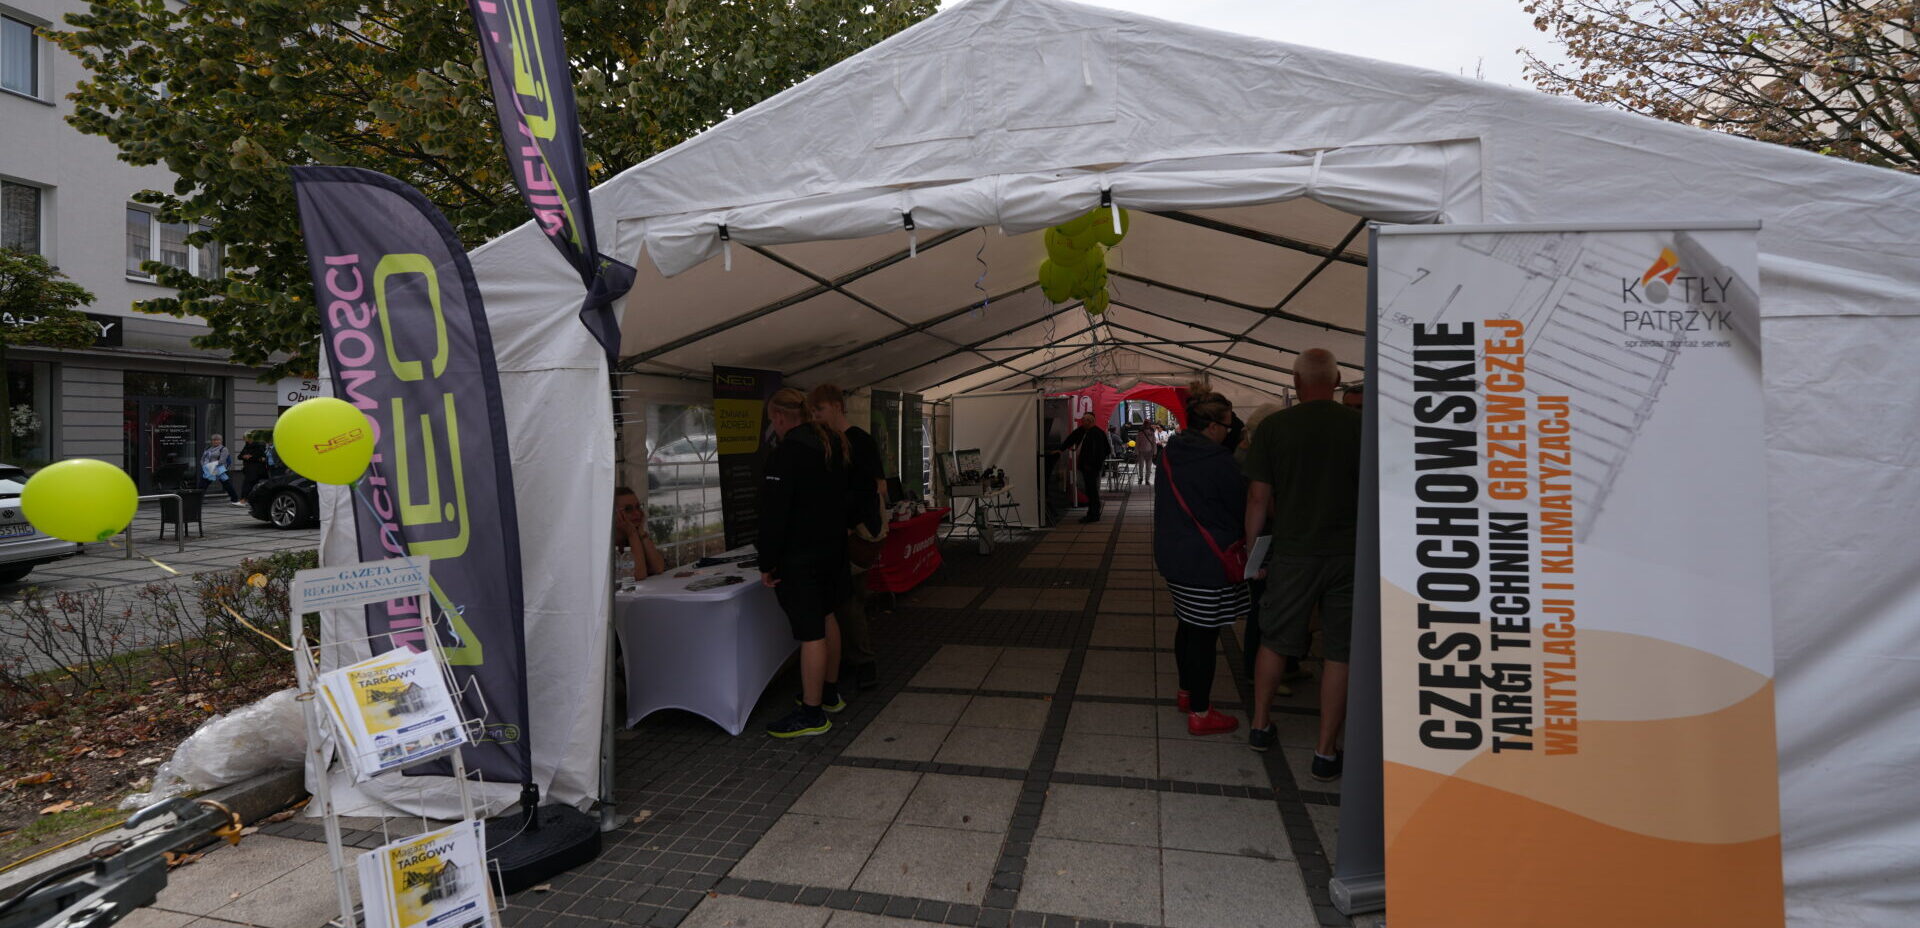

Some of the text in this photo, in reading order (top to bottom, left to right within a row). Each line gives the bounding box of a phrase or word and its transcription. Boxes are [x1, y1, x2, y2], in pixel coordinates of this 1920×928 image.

[1623, 310, 1733, 331] PATRZYK
[1701, 340, 1731, 348] serwis
[715, 374, 755, 387] NEO
[313, 428, 362, 451] NEO
[1484, 319, 1533, 754] TARGI TECHNIKI GRZEWCZEJ
[338, 565, 392, 580] GAZETA
[1537, 395, 1579, 756] WENTYLACJI I KLIMATYZACJI
[303, 572, 422, 598] REGIONALNA.COM
[350, 666, 397, 681] Magazyn
[358, 668, 417, 689] TARGOWY
[391, 840, 436, 860] Magazyn
[397, 842, 455, 870] TARGOWY
